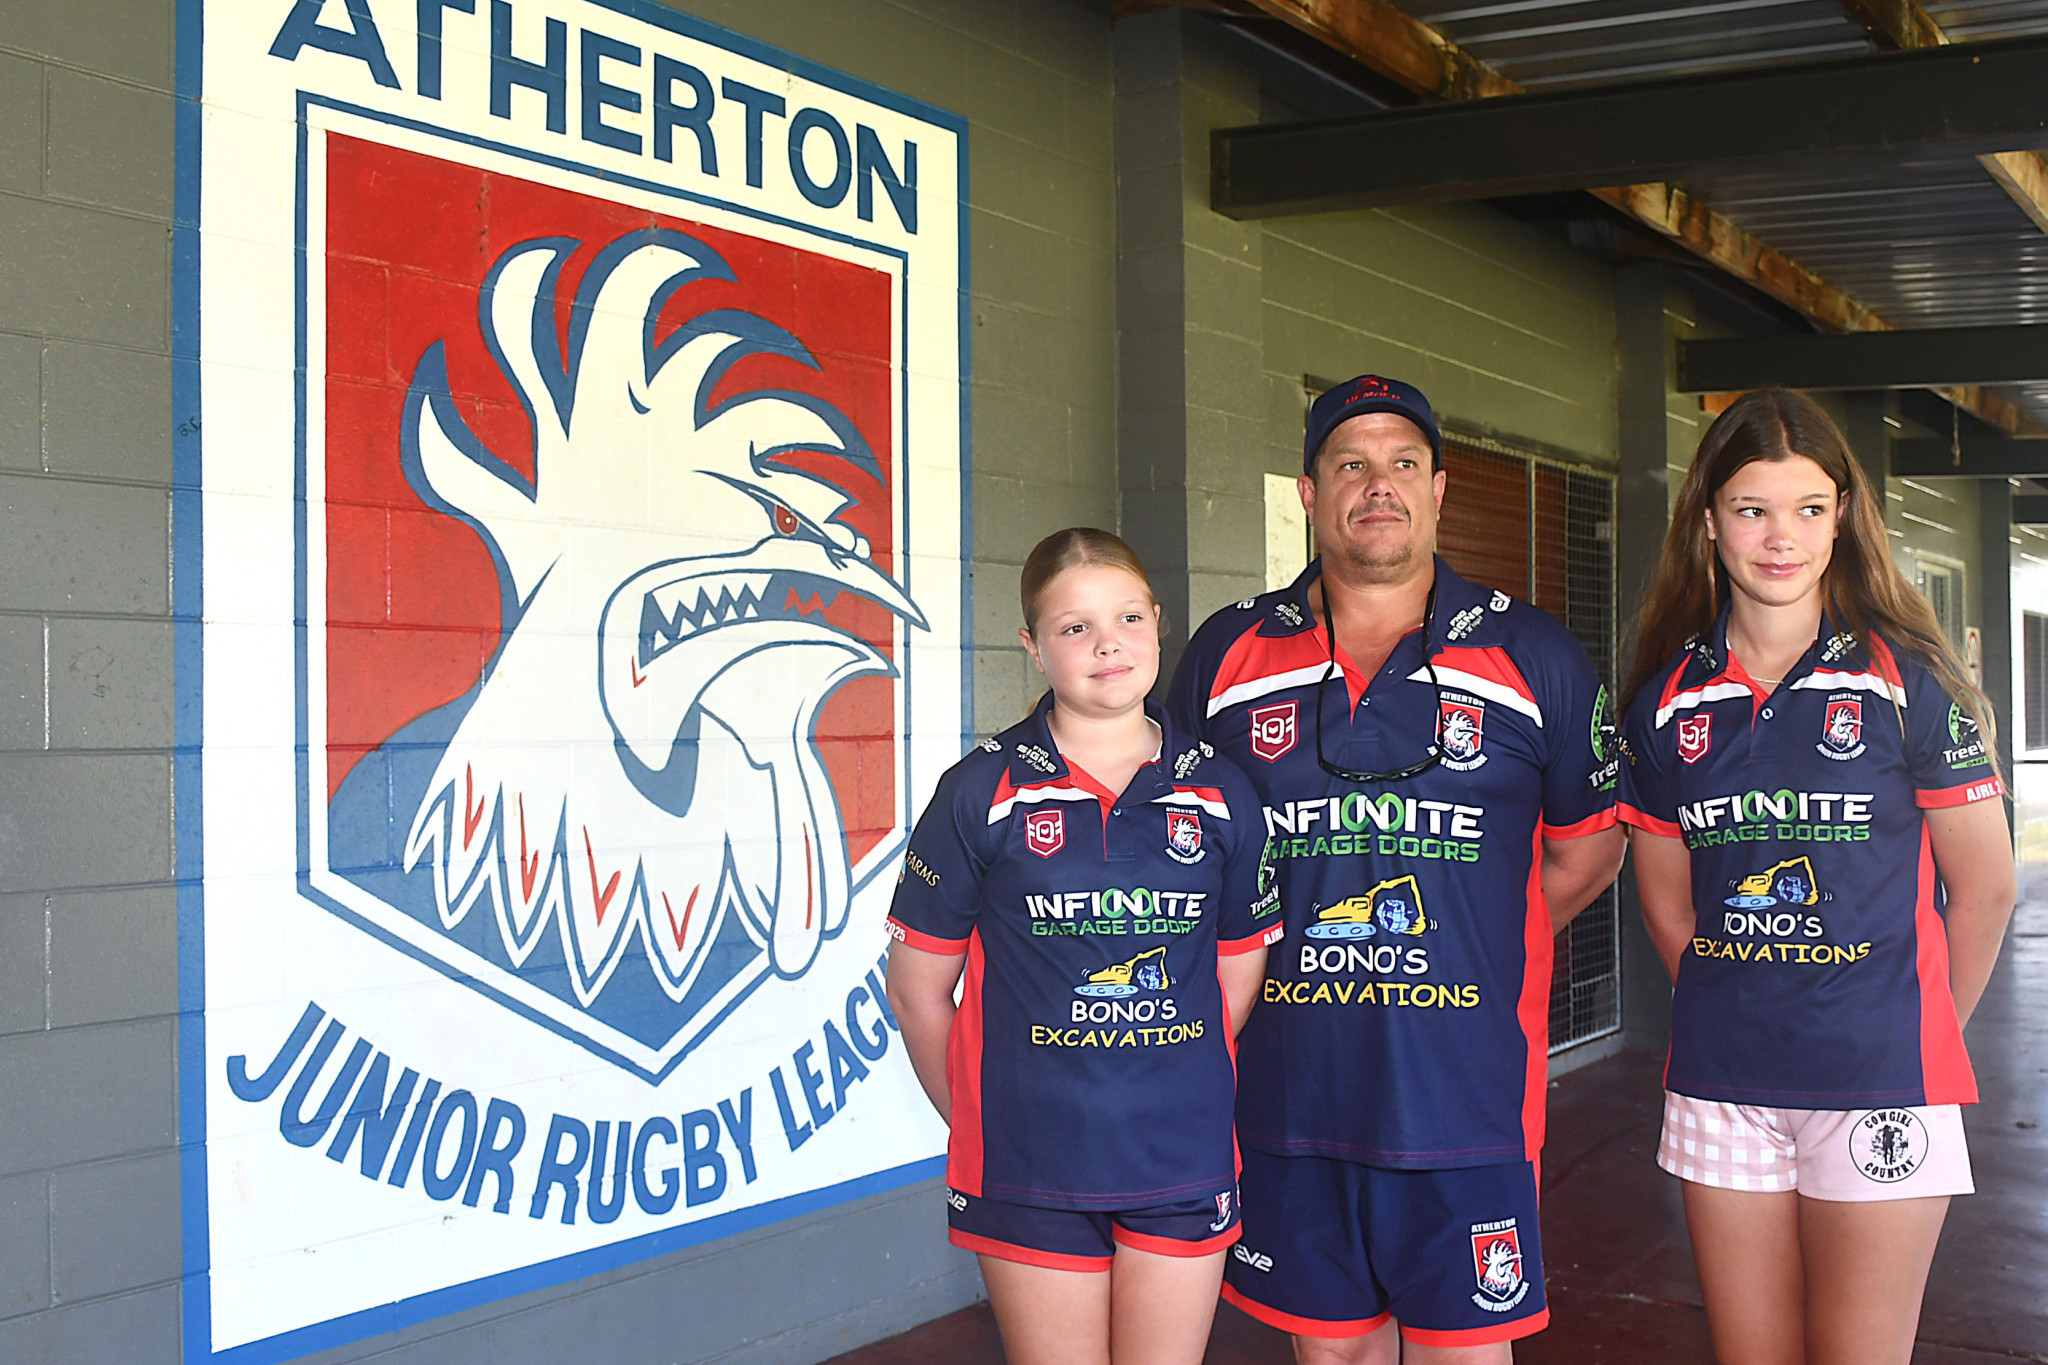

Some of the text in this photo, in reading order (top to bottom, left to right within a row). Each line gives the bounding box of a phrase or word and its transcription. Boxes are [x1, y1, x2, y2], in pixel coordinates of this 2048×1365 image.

[268, 0, 917, 235] ATHERTON
[1446, 605, 1484, 641] SIGNS
[1016, 744, 1057, 774] SIGNS
[1966, 782, 1997, 802] AJRL
[1262, 792, 1484, 839] NFINITE
[1775, 824, 1870, 842] DOORS
[1272, 834, 1371, 860] ARAGE
[1377, 834, 1481, 863] DOORS
[906, 851, 940, 887] FARMS
[1025, 887, 1207, 919] INFINITE
[884, 920, 906, 943] 2025
[1031, 919, 1128, 936] GARAGE
[1300, 944, 1429, 975] BONO'S
[1264, 978, 1480, 1009] EXCAVATIONS
[1071, 998, 1177, 1024] BONO'S
[1031, 1020, 1204, 1048] EXCAVATIONS
[227, 947, 899, 1225] JUNIOR RUGBY LEAG
[1864, 1111, 1912, 1128] COWGIRL
[1864, 1159, 1915, 1178] COUNTRY
